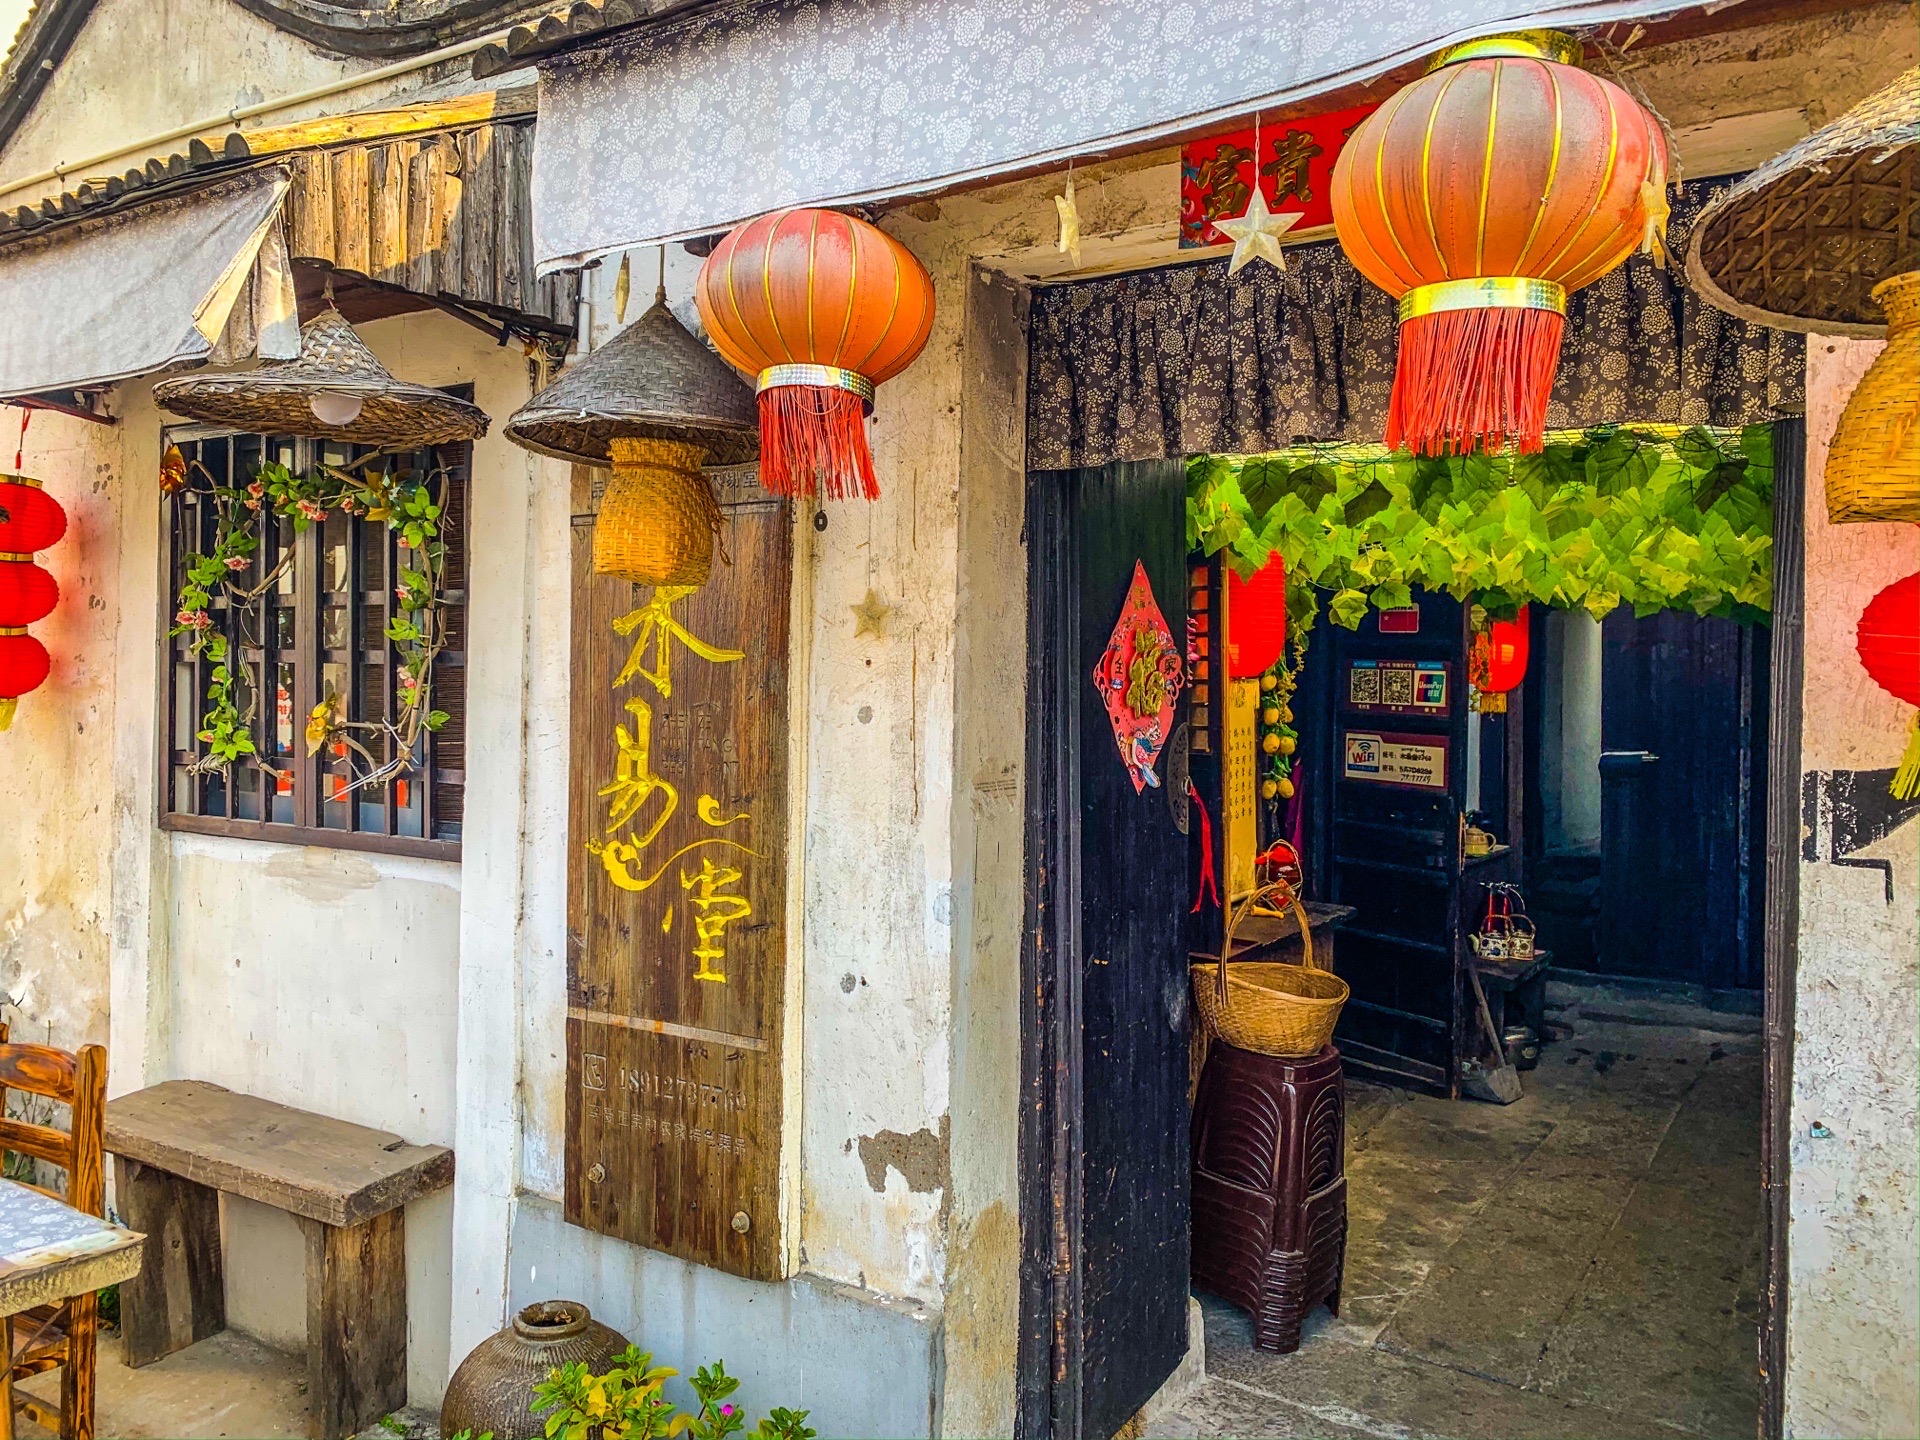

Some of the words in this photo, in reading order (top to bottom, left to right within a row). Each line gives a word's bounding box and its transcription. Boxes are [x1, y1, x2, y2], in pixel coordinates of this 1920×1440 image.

[1114, 656, 1124, 675] 全
[1164, 655, 1177, 676] 家
[1418, 681, 1442, 691] UnionPay
